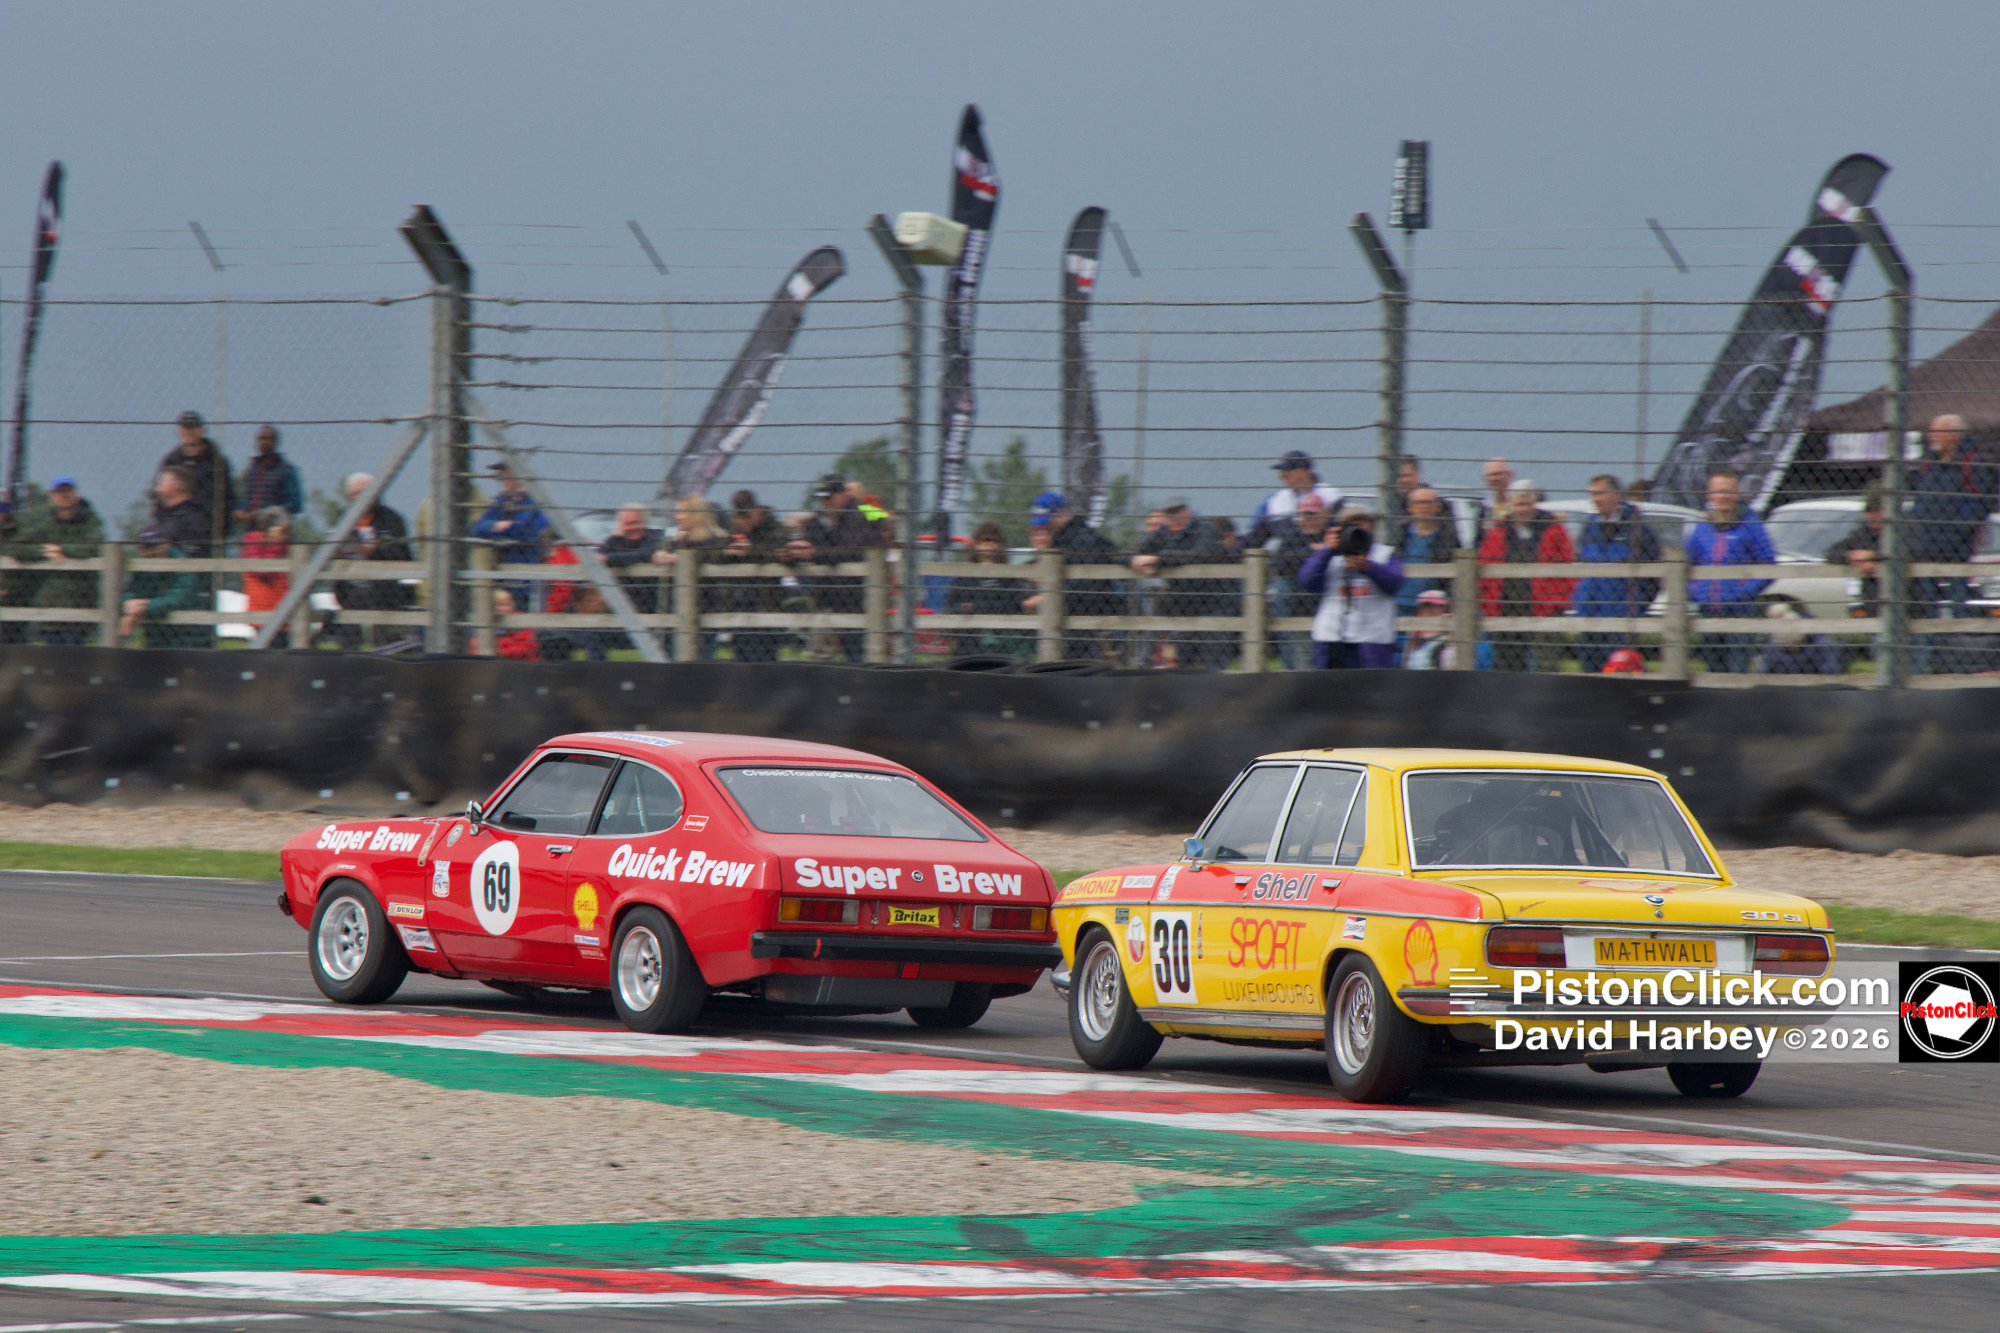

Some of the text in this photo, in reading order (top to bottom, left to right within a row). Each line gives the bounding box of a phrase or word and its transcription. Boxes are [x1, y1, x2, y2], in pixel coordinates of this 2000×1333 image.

[316, 824, 373, 855] Super
[368, 826, 421, 852] Brew
[607, 843, 755, 888] Quick Brew
[794, 858, 1022, 896] Super Brew
[484, 861, 511, 914] 69
[1066, 880, 1118, 896] SIMONIZ
[1253, 872, 1318, 901] Shell
[396, 906, 423, 914] DUNLOP
[577, 900, 595, 911] SHELL
[894, 909, 936, 923] Britax
[1154, 919, 1190, 993] 30
[1228, 917, 1307, 971] SPORT
[1599, 941, 1715, 963] MATHWALL
[1223, 980, 1315, 1004] LUXEMBOURG
